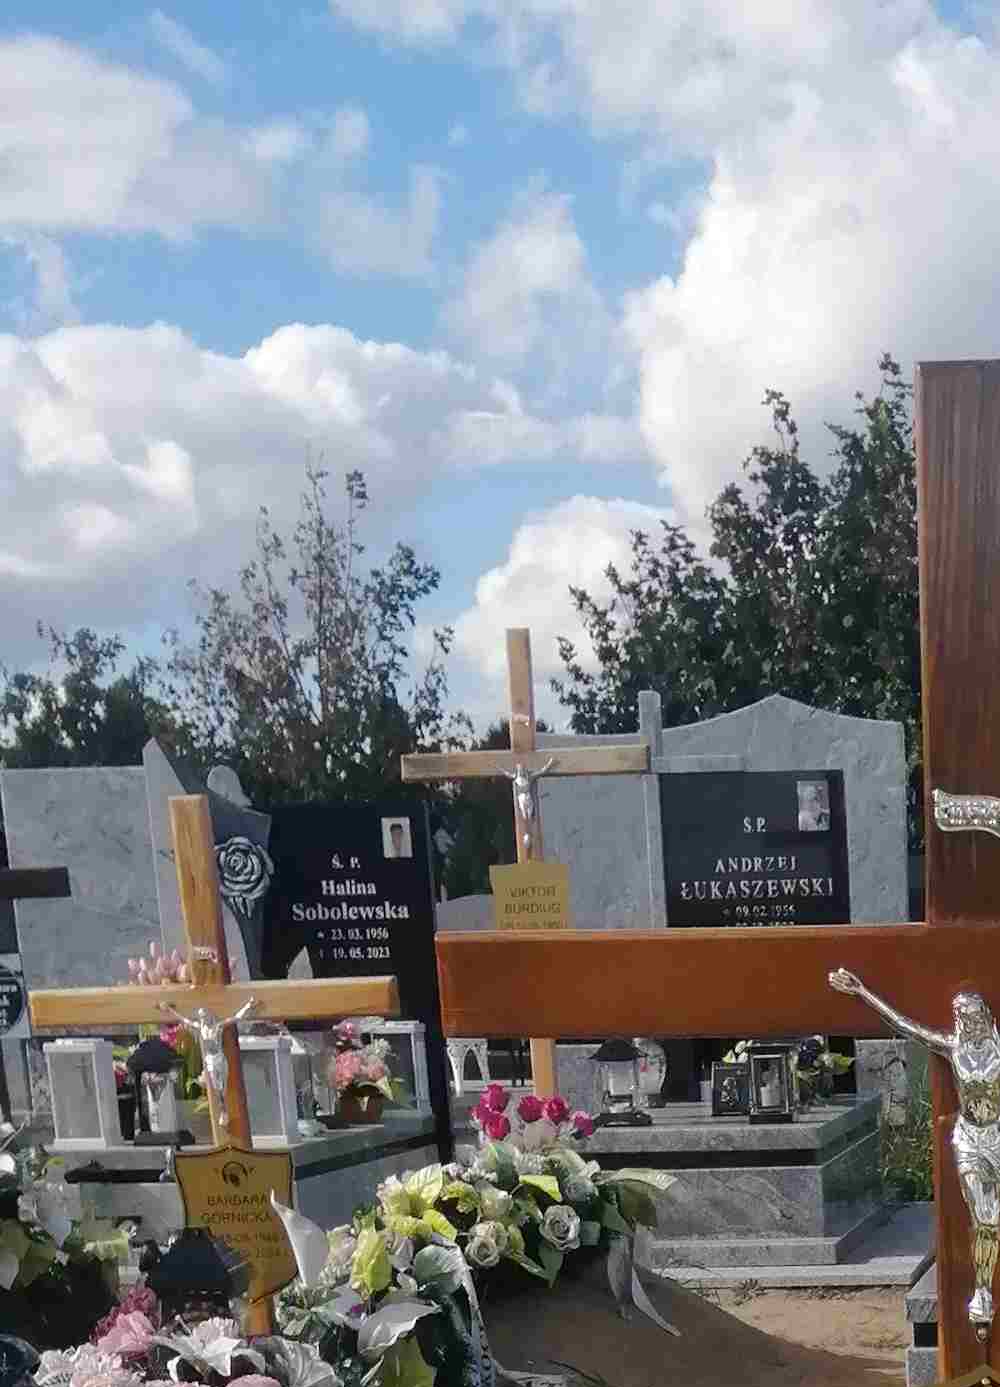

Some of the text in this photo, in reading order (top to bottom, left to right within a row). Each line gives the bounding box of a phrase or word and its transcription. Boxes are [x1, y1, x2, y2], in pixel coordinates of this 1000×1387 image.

[714, 856, 797, 873] ANDRZEJ
[320, 879, 377, 896] Halina
[680, 877, 834, 901] ŁUKASZEWSKI
[291, 900, 410, 921] Sobolewska
